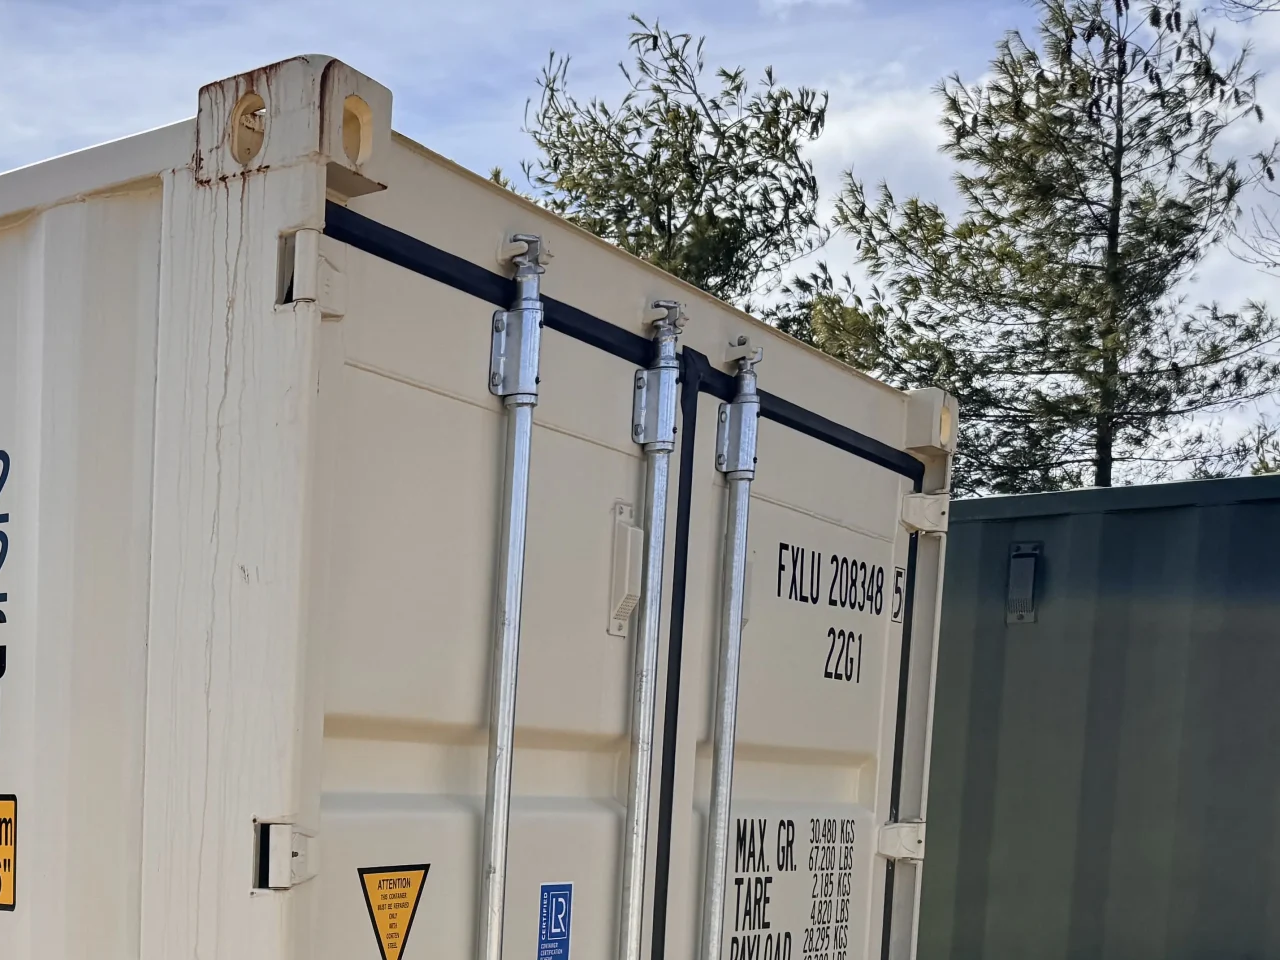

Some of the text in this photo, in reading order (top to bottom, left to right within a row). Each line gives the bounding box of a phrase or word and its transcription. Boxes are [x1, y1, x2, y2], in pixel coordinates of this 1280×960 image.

[777, 542, 903, 619] FXLU 208348 5
[824, 626, 863, 684] 22G1
[735, 818, 770, 873] MAX.
[776, 819, 797, 872] GR.
[840, 818, 855, 844] KGS
[838, 845, 854, 871] LBS
[377, 877, 411, 891] ATTENTION
[735, 876, 773, 932] TARE
[836, 872, 852, 897] KGS
[551, 897, 566, 933] LR
[835, 898, 850, 924] LBS
[833, 924, 848, 950] KGS
